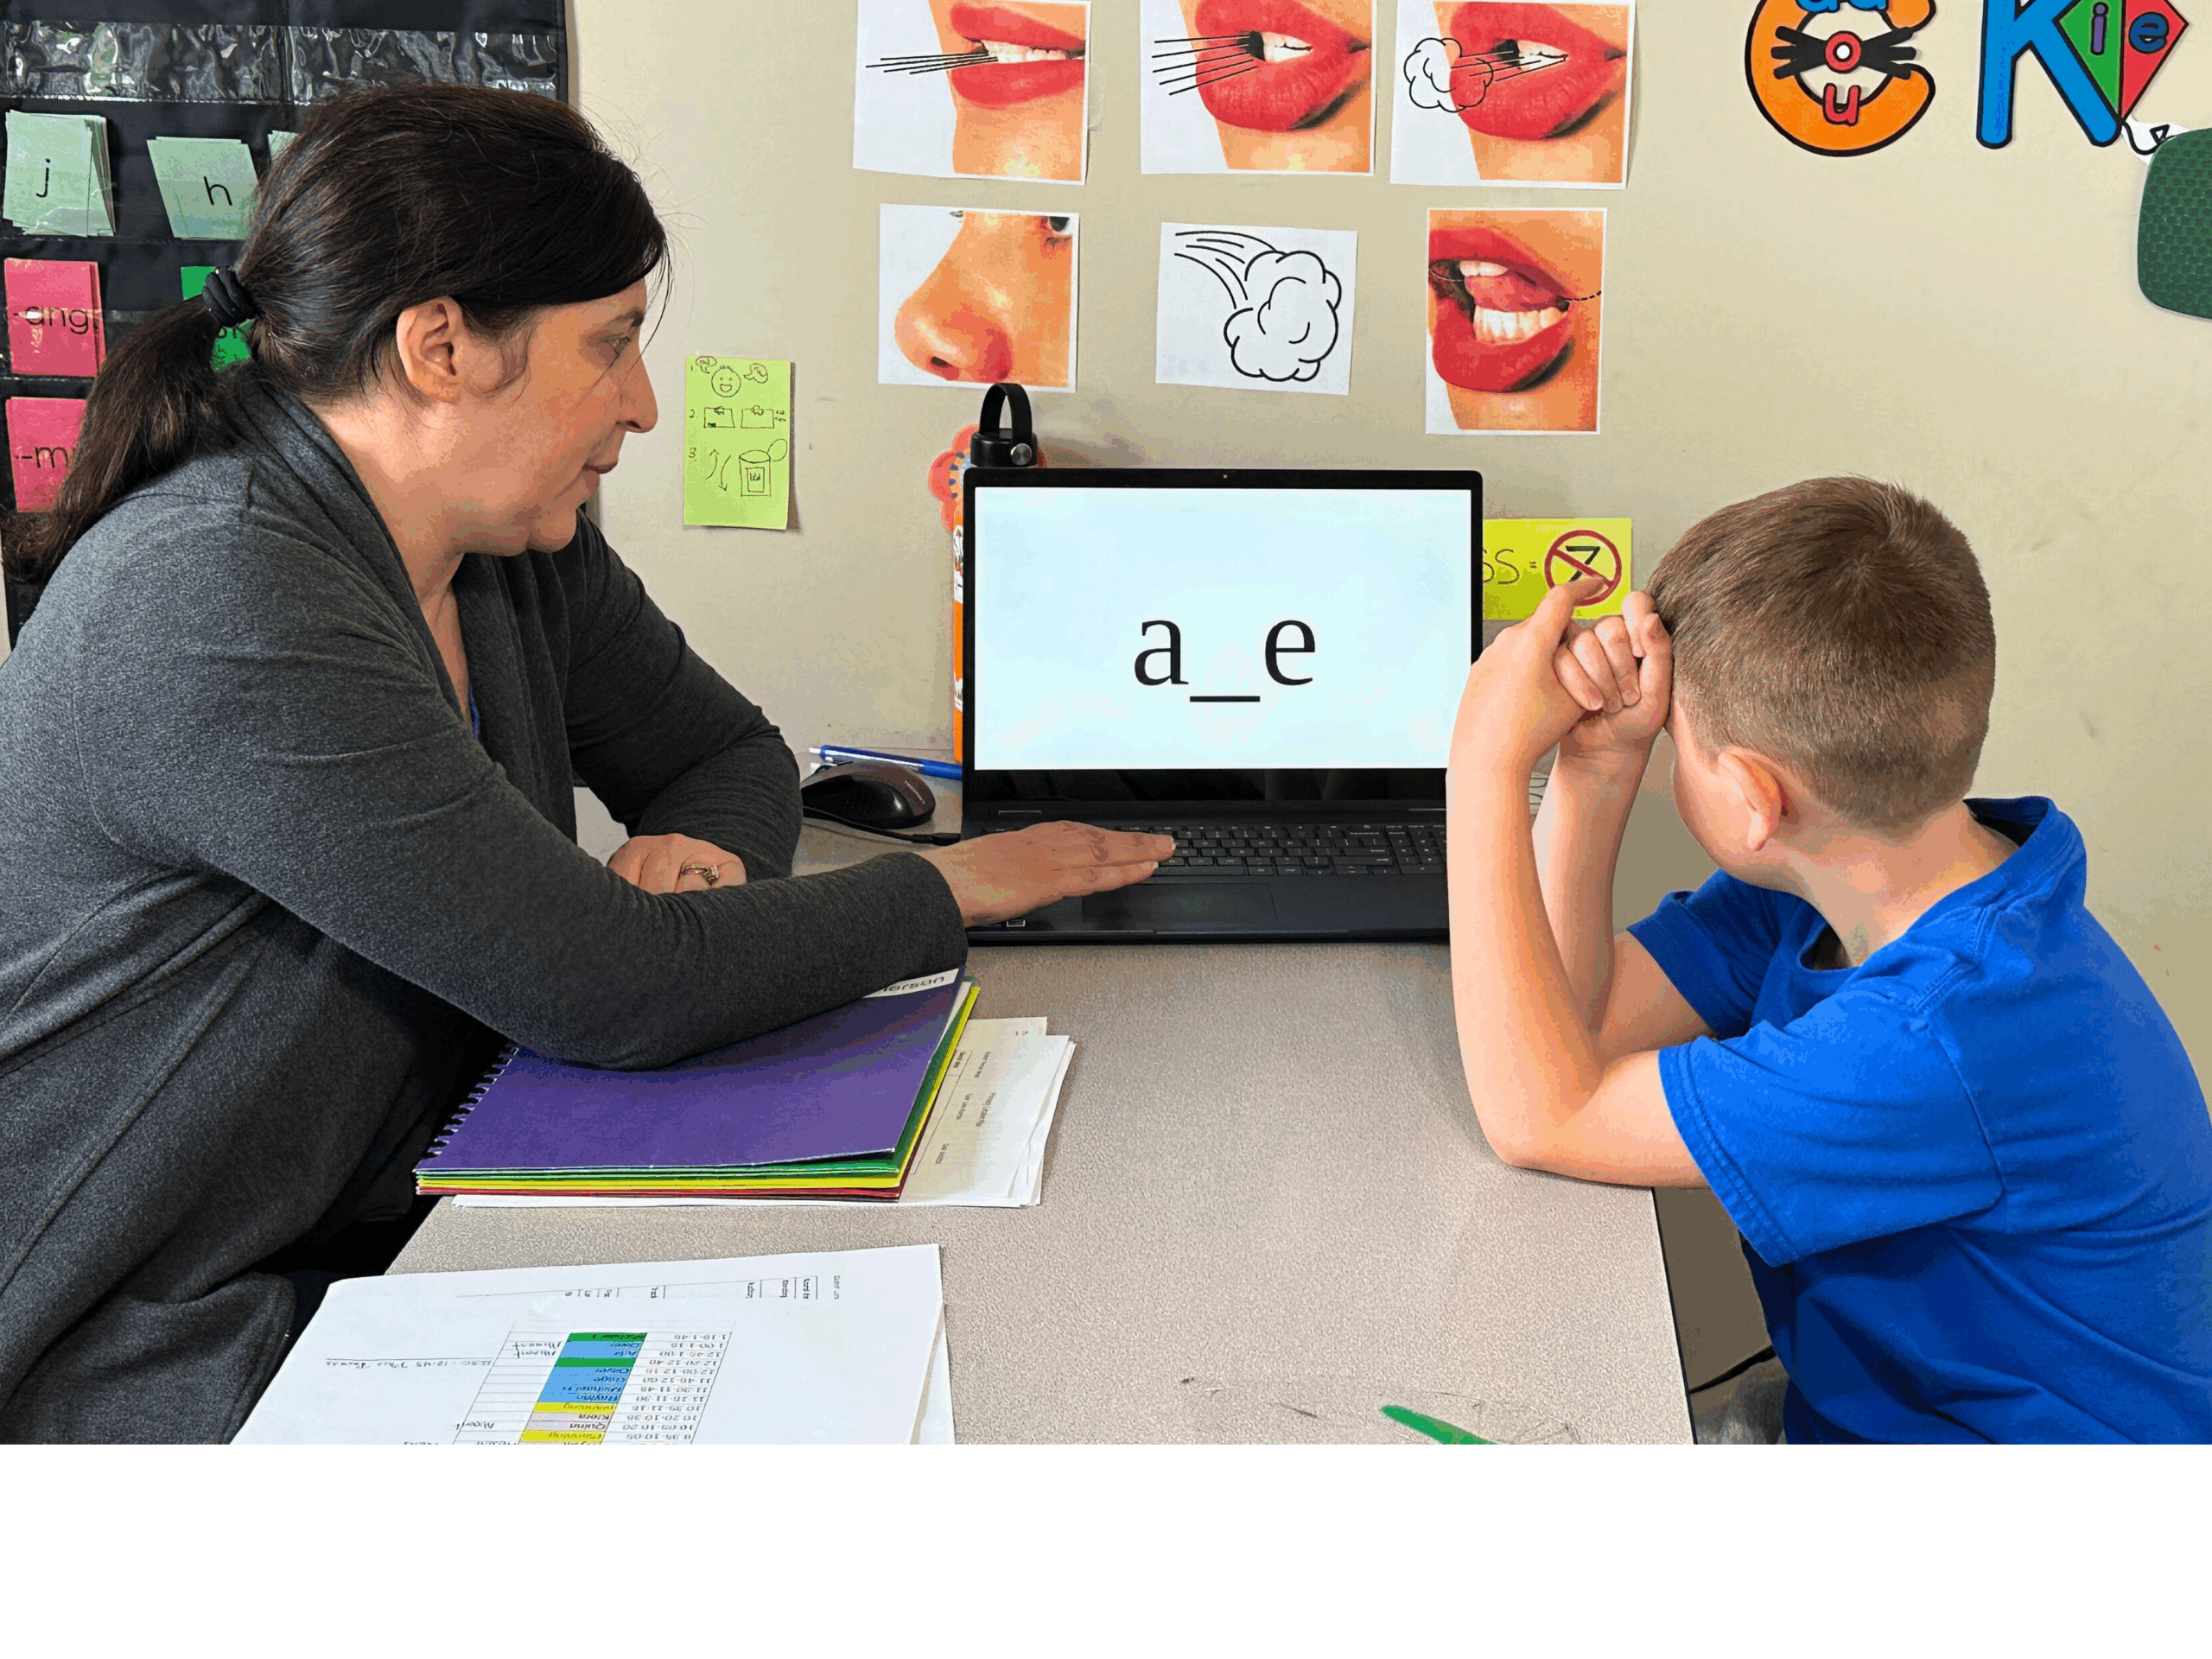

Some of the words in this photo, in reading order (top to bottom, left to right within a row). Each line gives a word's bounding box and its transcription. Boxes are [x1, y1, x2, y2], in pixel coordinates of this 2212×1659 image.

[2128, 11, 2170, 54] e
[1822, 82, 1861, 127] u
[36, 158, 51, 199] j
[203, 175, 232, 206] h
[15, 446, 76, 469] -m
[883, 976, 945, 992] erson
